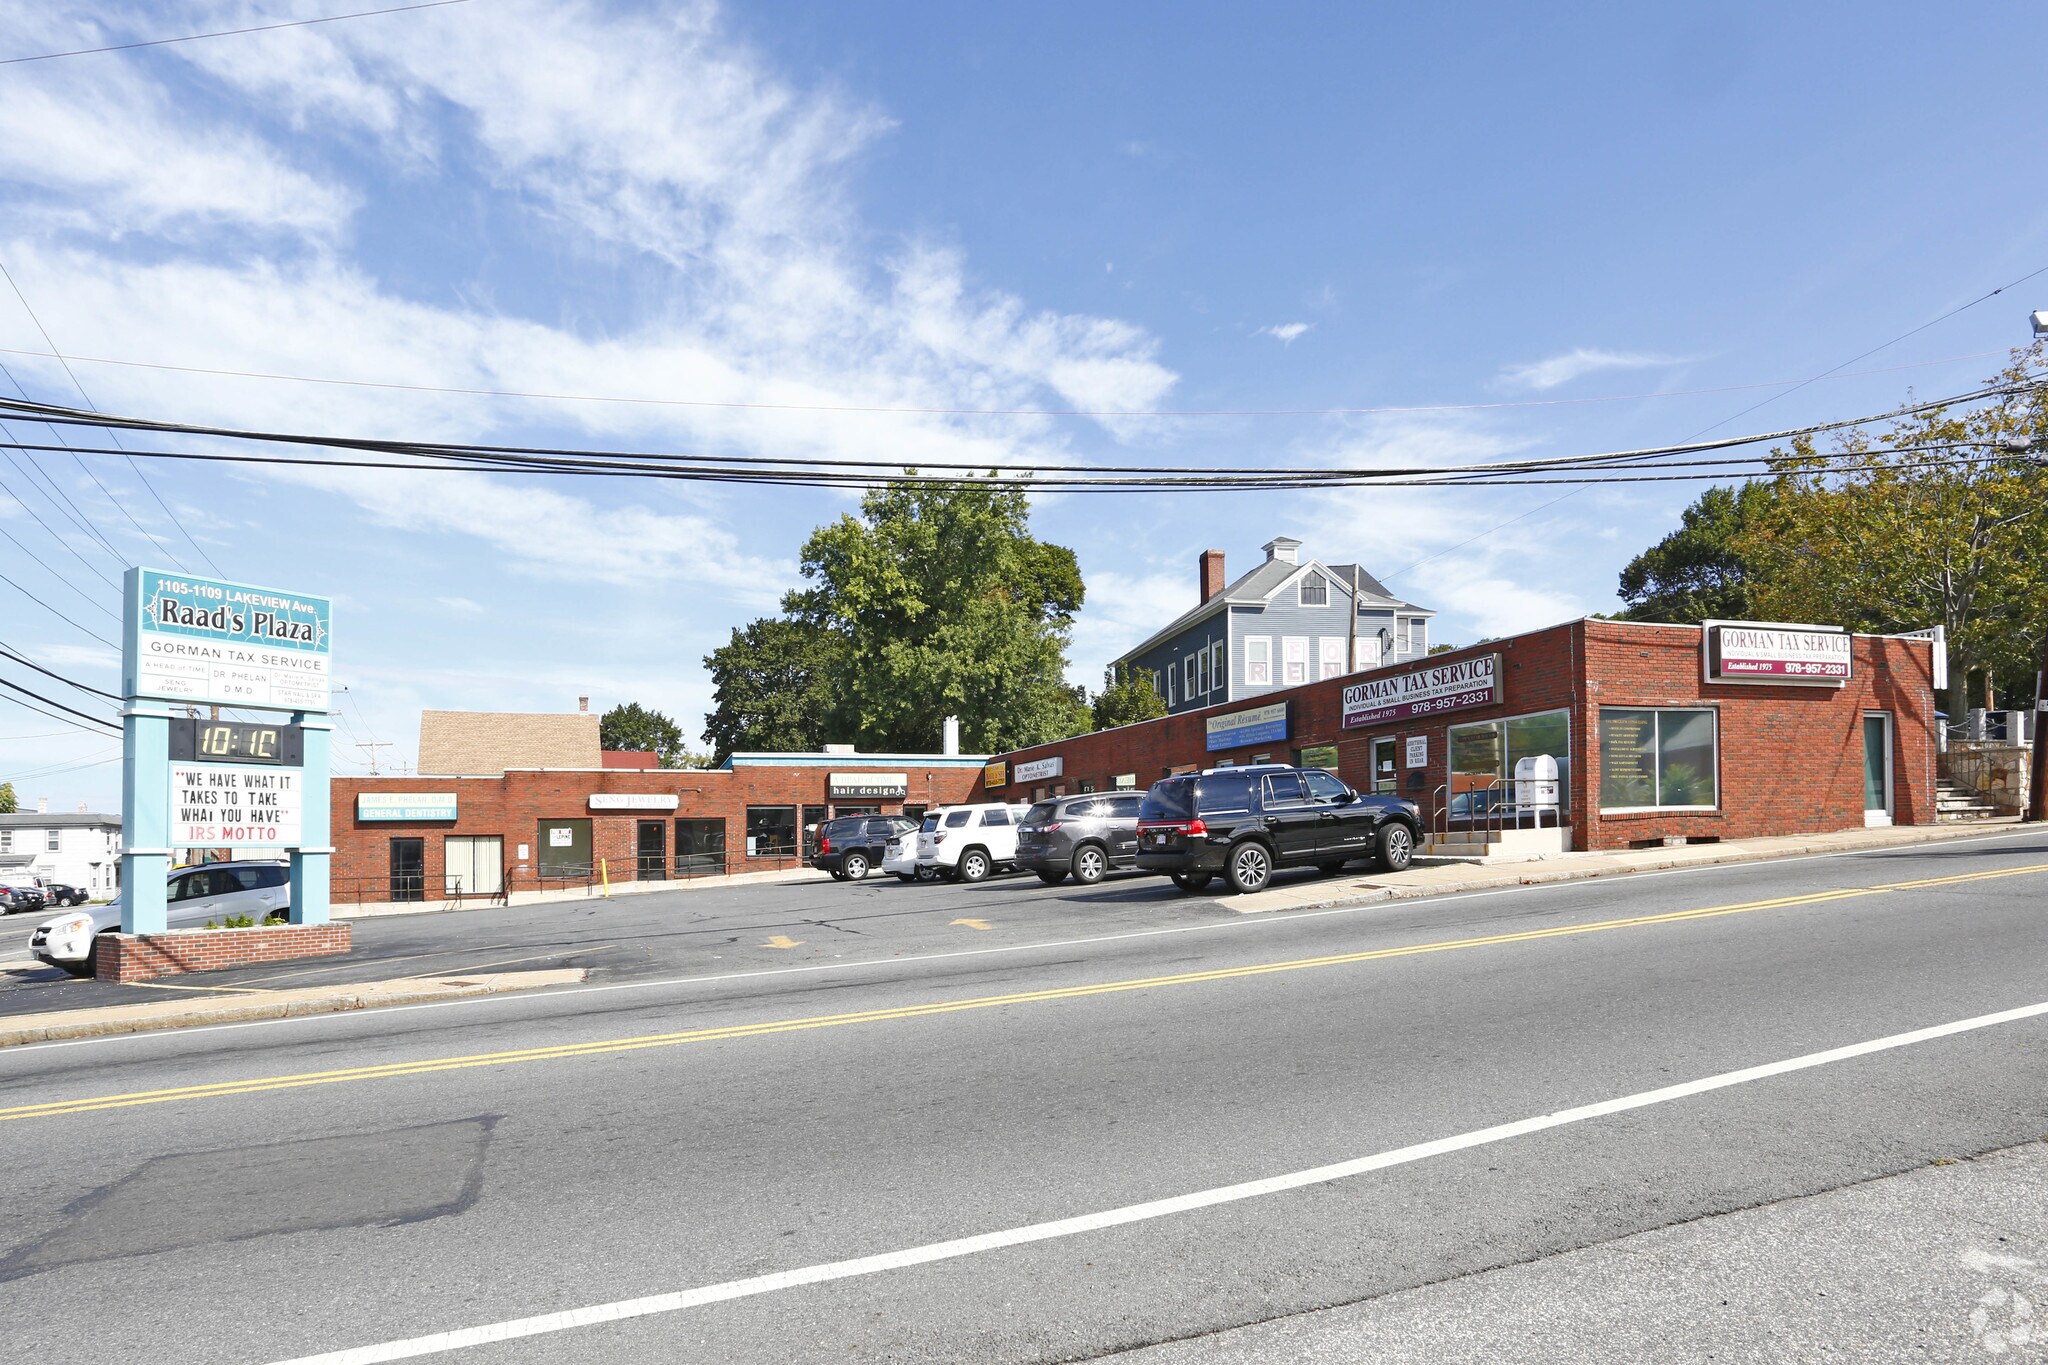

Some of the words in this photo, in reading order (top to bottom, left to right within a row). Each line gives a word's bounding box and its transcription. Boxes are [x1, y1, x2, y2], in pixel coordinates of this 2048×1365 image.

[158, 579, 222, 600] 1105-1109
[226, 590, 290, 610] LAKEVIEW
[292, 601, 317, 614] Ave.
[162, 599, 244, 632] Raad's
[254, 612, 312, 641] Plaza
[1722, 630, 1774, 649] GORMAN
[1778, 633, 1800, 650] TAX
[1804, 634, 1850, 652] SERVICE
[151, 642, 221, 658] GORMAN
[228, 651, 255, 662] TAX
[262, 655, 321, 670] SERVICE
[1728, 662, 1758, 670] Established
[1759, 663, 1772, 671] 1975
[1785, 662, 1845, 674] 978-957-2331
[232, 672, 266, 682] PHELAN
[1345, 678, 1398, 704] GORMAN
[1402, 672, 1428, 692] TAX
[1432, 658, 1493, 686] SERVICE
[158, 685, 194, 693] JEWELRY
[1349, 701, 1376, 712] INDIVIDUAL
[1383, 696, 1401, 705] SMALL
[1402, 691, 1430, 702] BUSINESS
[1444, 679, 1488, 693] PREPARATION
[1350, 712, 1380, 724] Established
[1382, 709, 1396, 718] 1975
[1411, 690, 1489, 714] 978-957-2331
[1212, 716, 1236, 729] Original
[1237, 712, 1261, 724] Résumé
[210, 774, 236, 788] HAVE
[244, 775, 274, 789] WHAT
[280, 776, 290, 790] IT
[182, 790, 218, 804] TAKES
[224, 791, 238, 805] TO
[248, 792, 278, 806] TAKE
[860, 787, 895, 795] design
[221, 809, 242, 822] YOU
[363, 809, 402, 818] GENERAL
[405, 809, 452, 818] DENTISTRY
[189, 826, 216, 840] IRS
[222, 827, 276, 840] MOTTO
